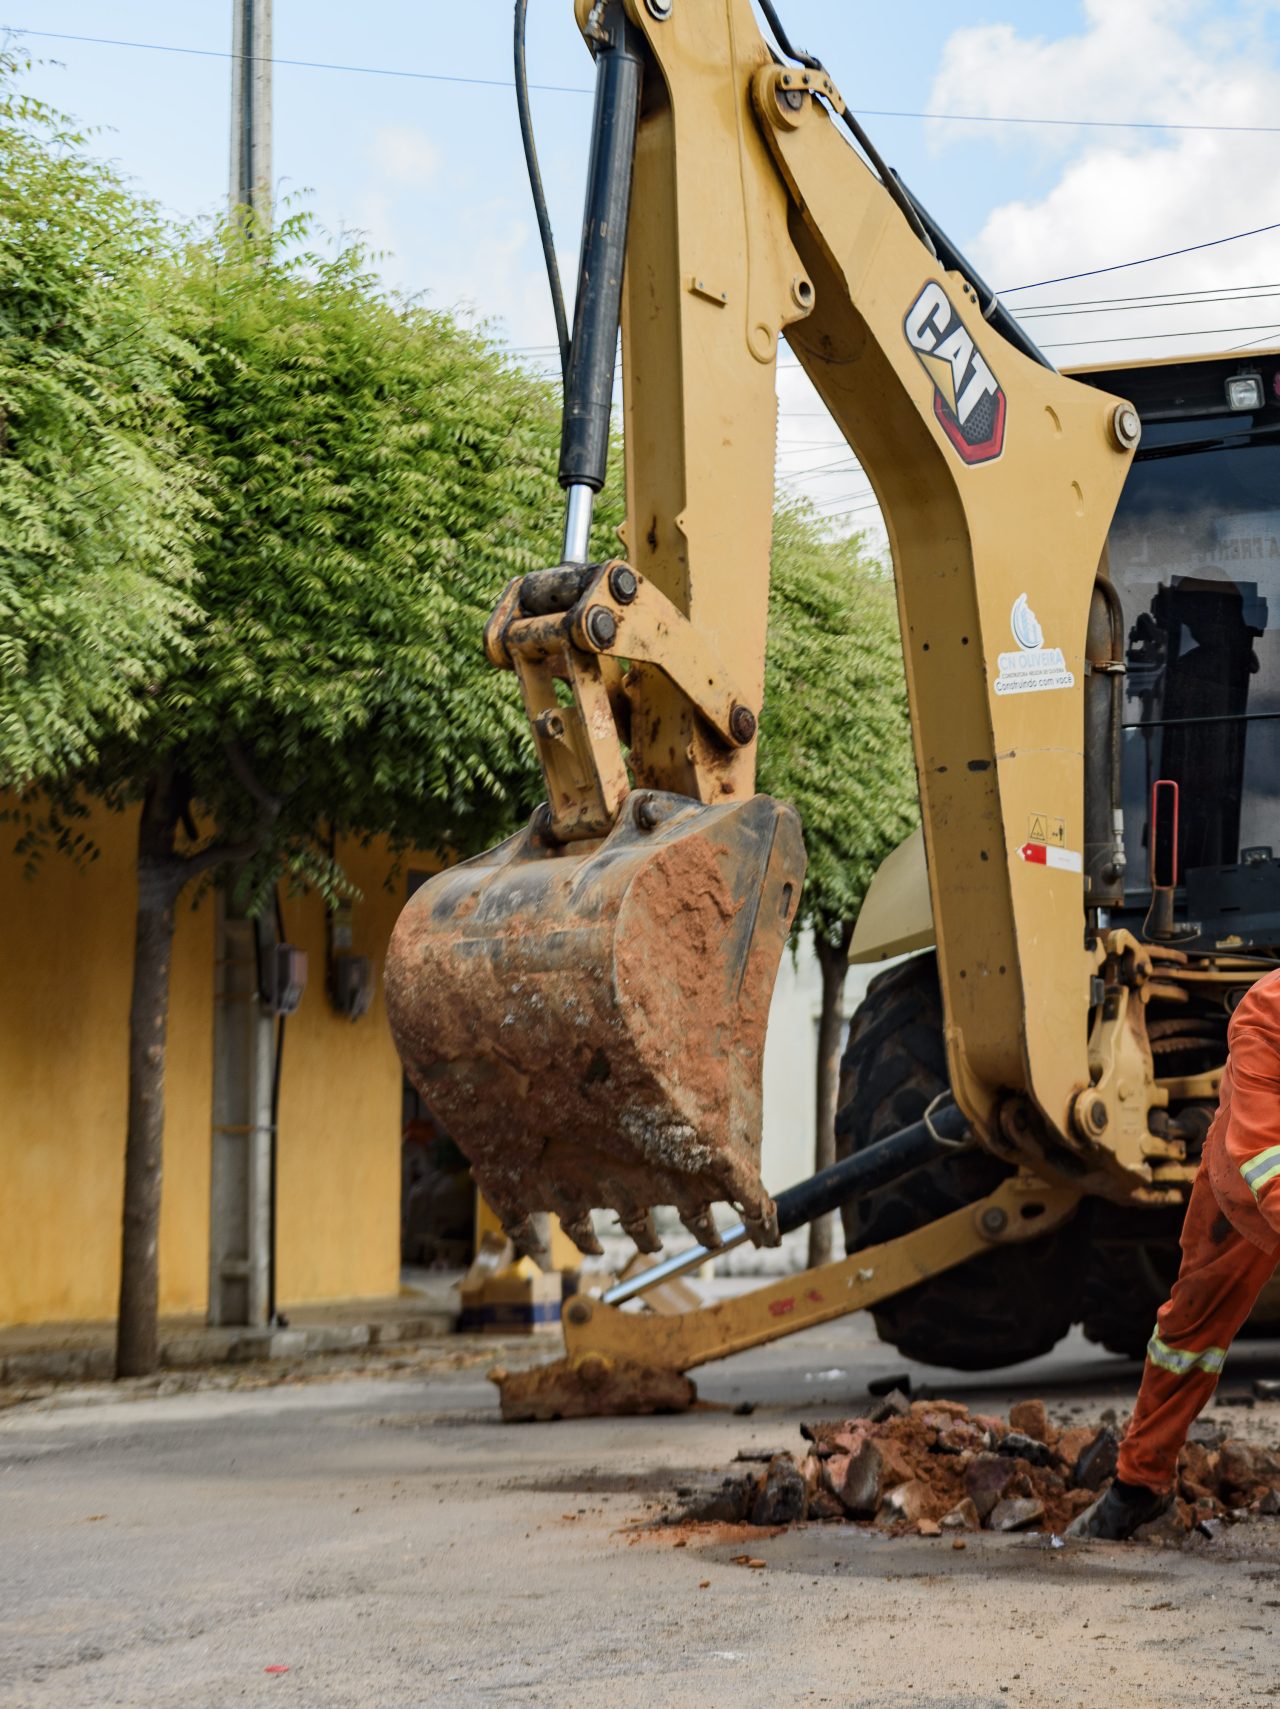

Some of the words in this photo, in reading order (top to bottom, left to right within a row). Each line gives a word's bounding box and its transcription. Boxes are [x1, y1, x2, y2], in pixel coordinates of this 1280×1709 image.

[905, 282, 999, 426] CAT
[1018, 651, 1063, 668] OLIVEIRA
[996, 679, 1037, 691] Construindo
[1039, 678, 1054, 687] com
[1056, 673, 1073, 684] você
